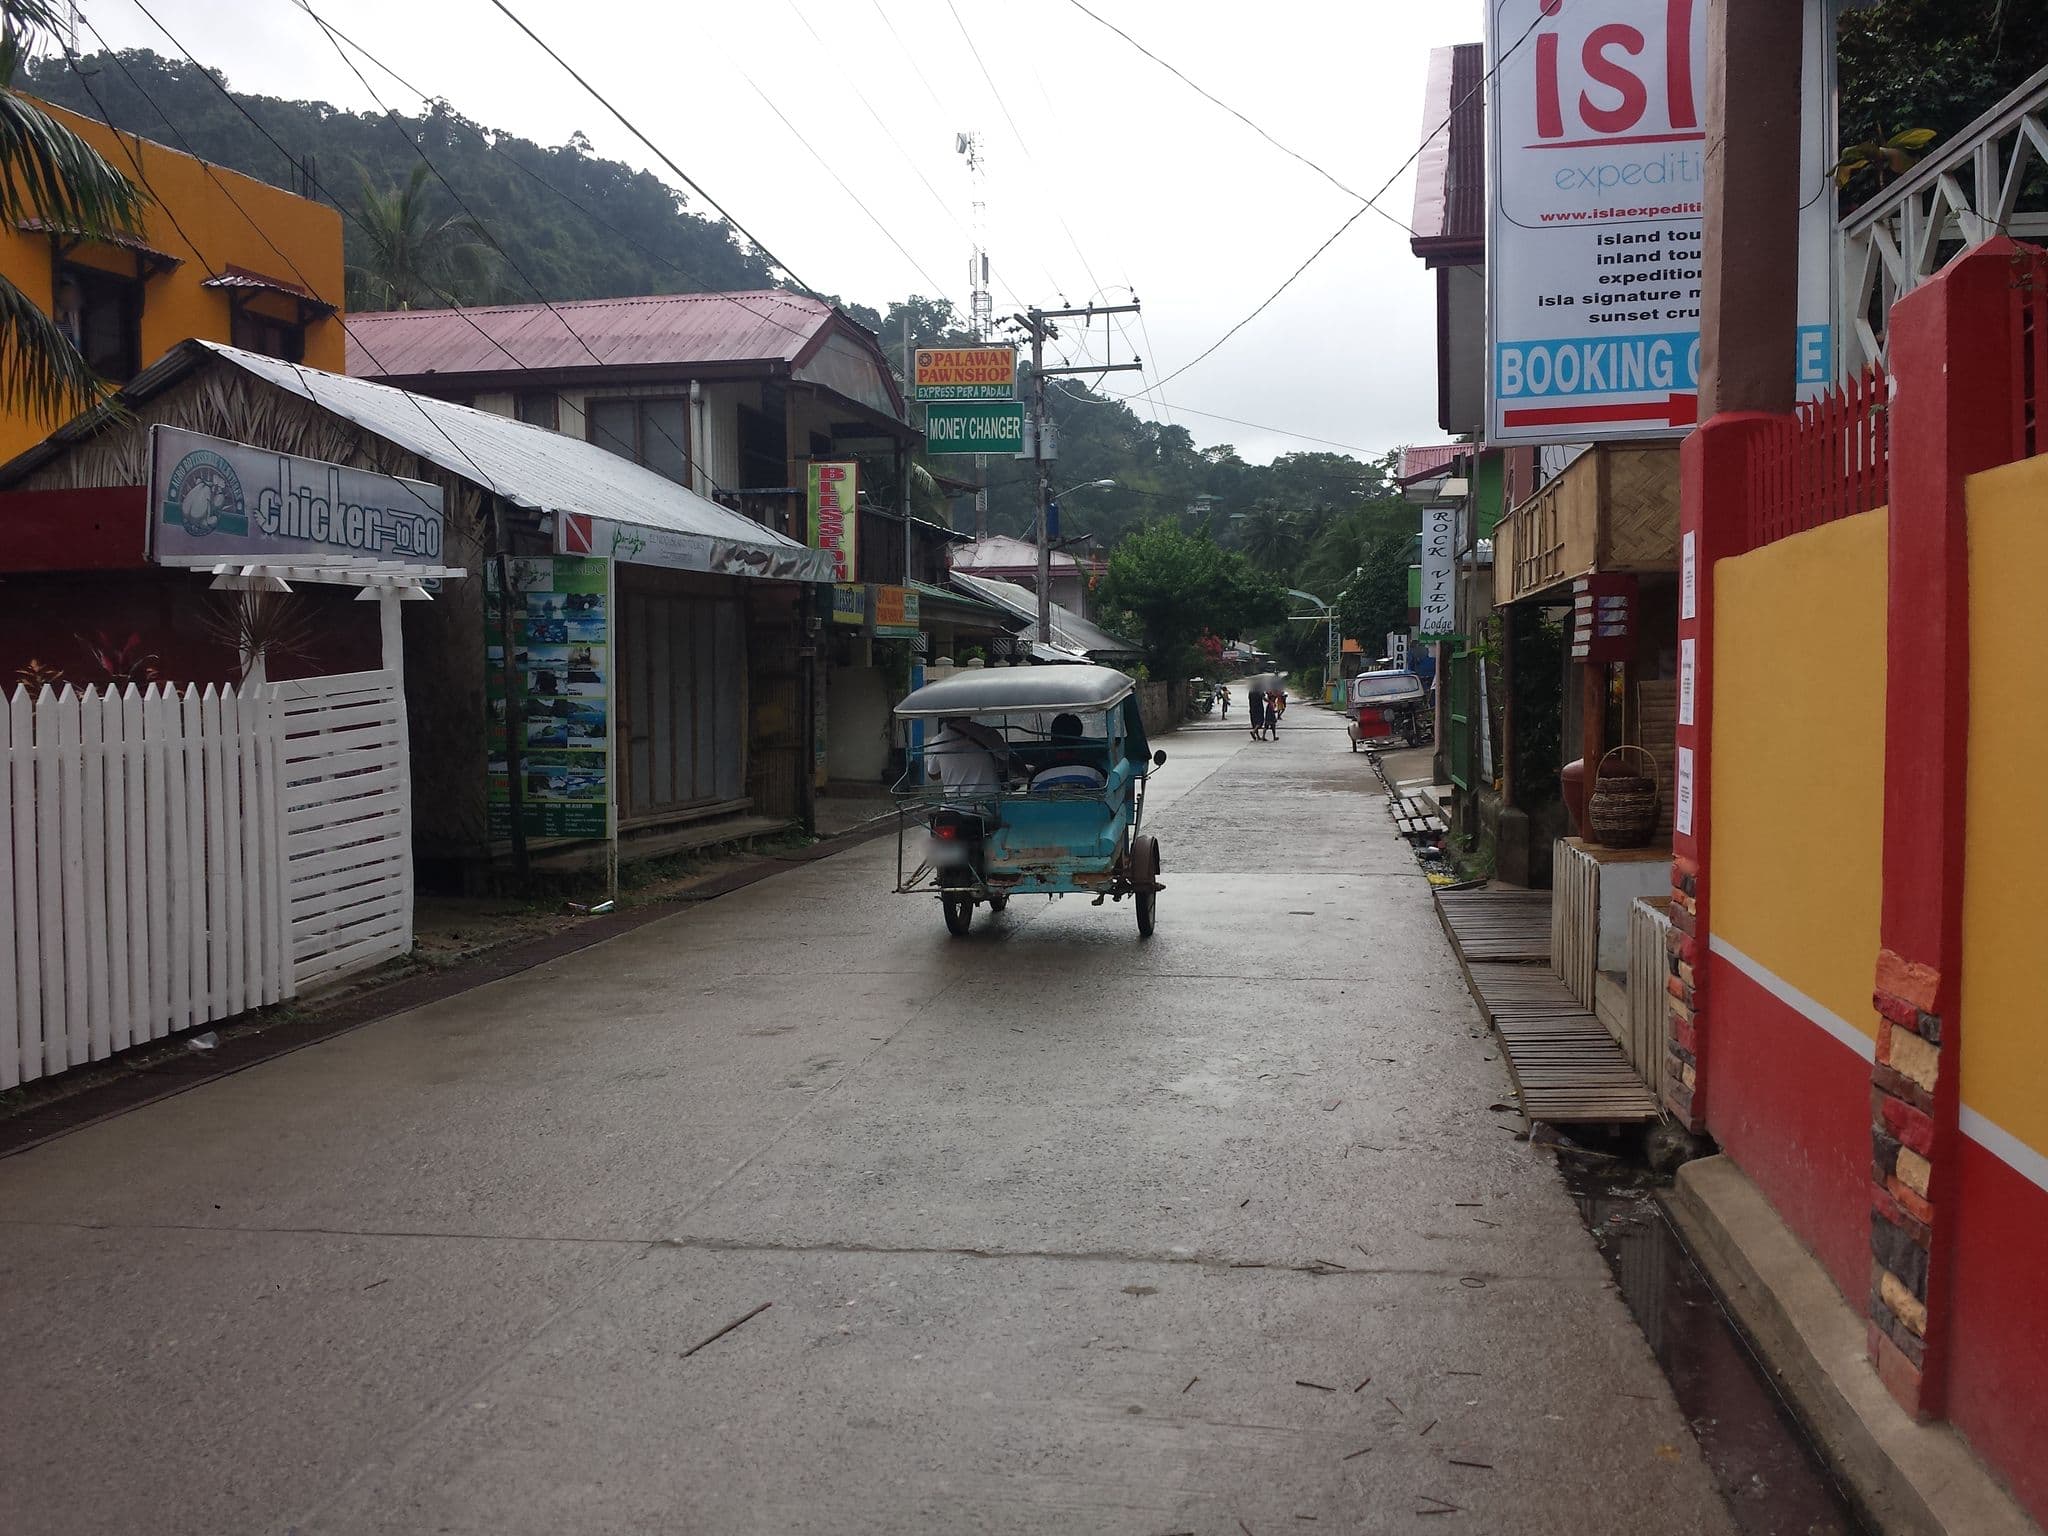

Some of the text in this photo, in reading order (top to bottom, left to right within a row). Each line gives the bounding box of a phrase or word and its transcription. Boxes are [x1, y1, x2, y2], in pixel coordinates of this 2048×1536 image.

[1535, 0, 1698, 138] isl
[1555, 151, 1704, 197] expediti
[1540, 202, 1703, 222] www.islaexpediti
[1597, 230, 1701, 246] island tou
[1597, 250, 1701, 265] inland tou
[1538, 294, 1574, 307] isla
[1582, 288, 1681, 305] signature
[1589, 308, 1699, 323] sunset cru
[934, 351, 1011, 367] PALAWAN
[1501, 338, 1674, 397] BOOKING
[918, 367, 1011, 382] PAWNSHOP
[918, 385, 1011, 398] EXPRESS PERA PADALA
[930, 417, 1021, 440] MONEY CHANGER
[257, 456, 440, 557] chicken to GO
[1424, 511, 1452, 614] ROCK VIEW
[1424, 617, 1452, 634] Lodge
